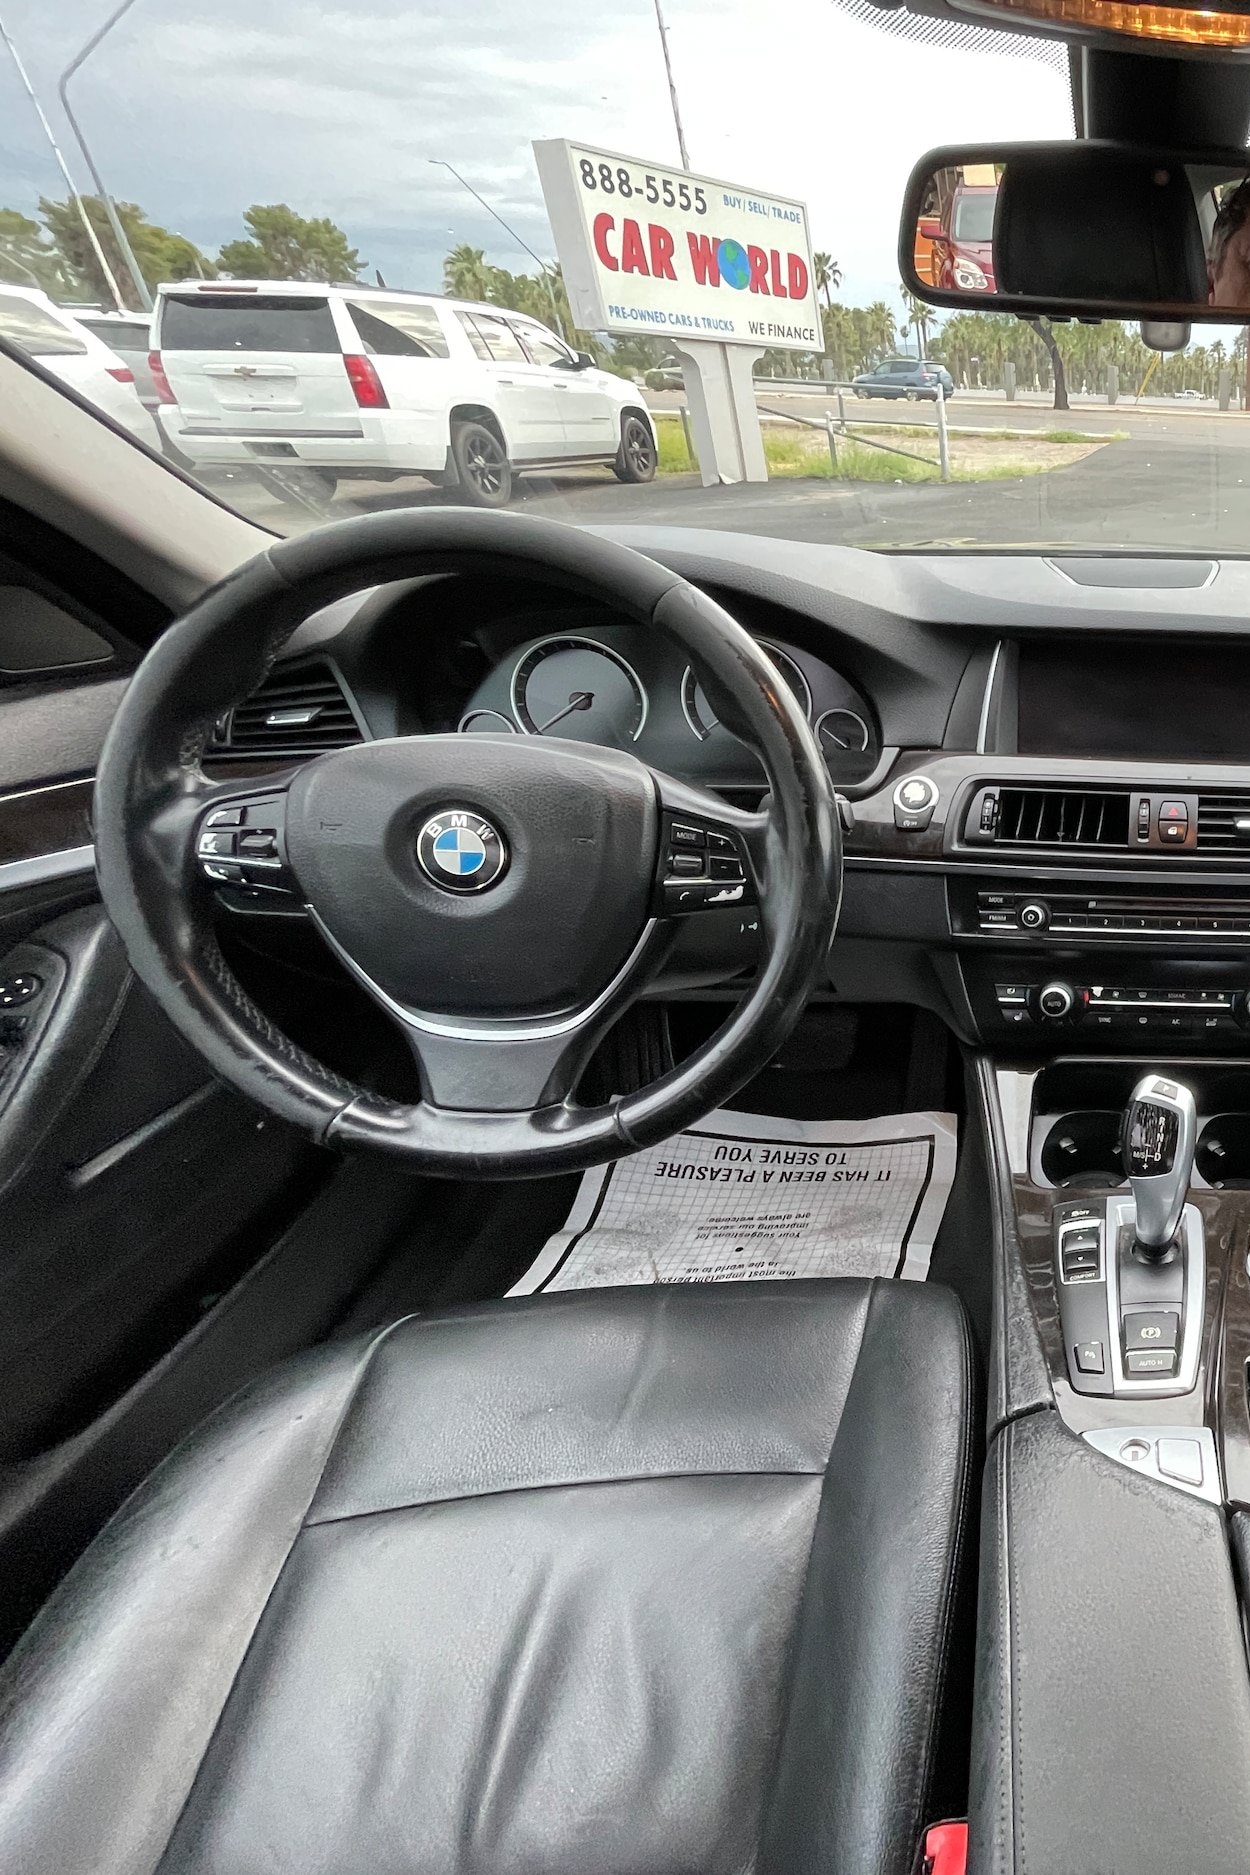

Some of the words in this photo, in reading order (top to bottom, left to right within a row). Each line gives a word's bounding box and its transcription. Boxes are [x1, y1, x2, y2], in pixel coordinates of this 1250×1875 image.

[579, 158, 708, 215] 888-5555
[593, 212, 678, 282] CAR
[608, 305, 667, 324] PRE-OWNED
[668, 313, 693, 327] CARS
[694, 316, 700, 328] &
[701, 317, 735, 332] TRUCKS
[748, 321, 765, 336] WE
[768, 323, 815, 341] FINANCE
[426, 815, 494, 840] BMW
[676, 831, 697, 841] MODE
[713, 1146, 753, 1163] YOU
[759, 1150, 820, 1165] SERVE
[825, 1152, 847, 1165] TO
[654, 1161, 756, 1183] PLEASURE
[763, 1170, 775, 1182] A
[779, 1170, 827, 1183] BEEN
[832, 1170, 869, 1182] HAS
[875, 1170, 892, 1181] IT
[715, 1264, 745, 1272] world
[1069, 1272, 1096, 1281] COMFORT
